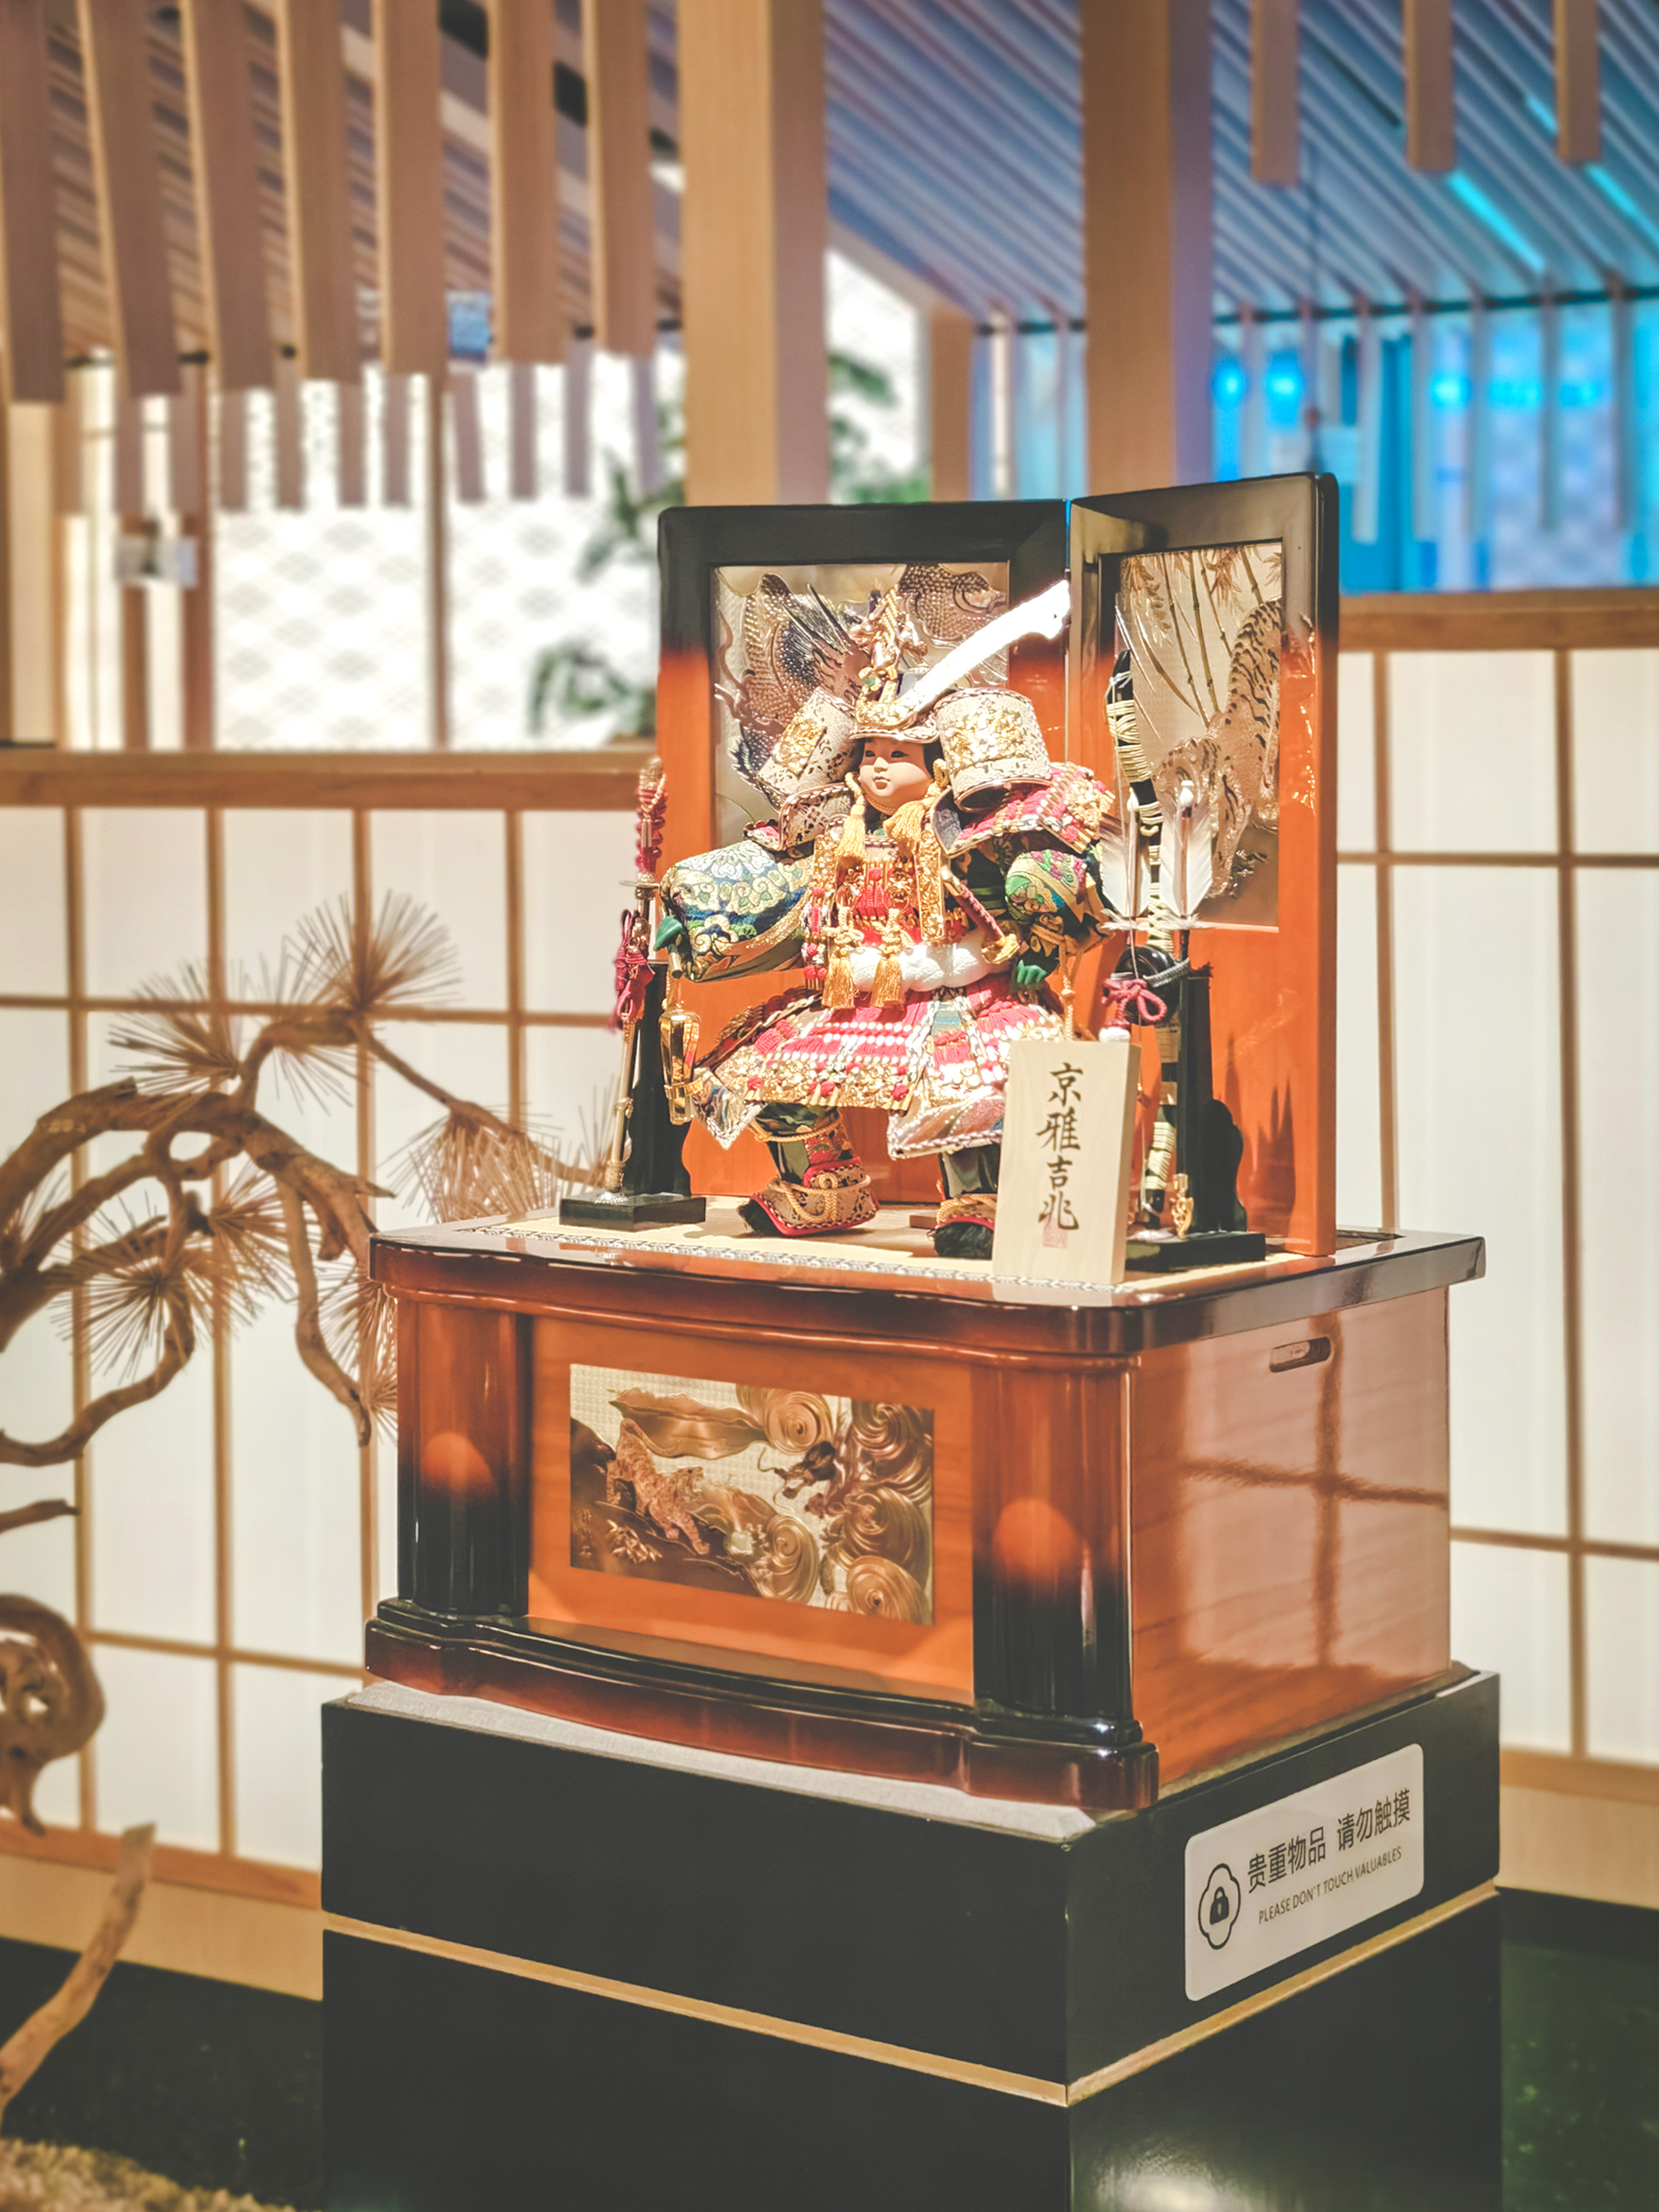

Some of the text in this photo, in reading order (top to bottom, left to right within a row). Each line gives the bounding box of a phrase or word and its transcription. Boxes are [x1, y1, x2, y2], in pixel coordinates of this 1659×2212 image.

[1248, 1787, 1411, 1893] 贵重物品 请勿触摸
[1258, 1846, 1402, 1924] PLEASE DON'T TOUCH VALUABLES
